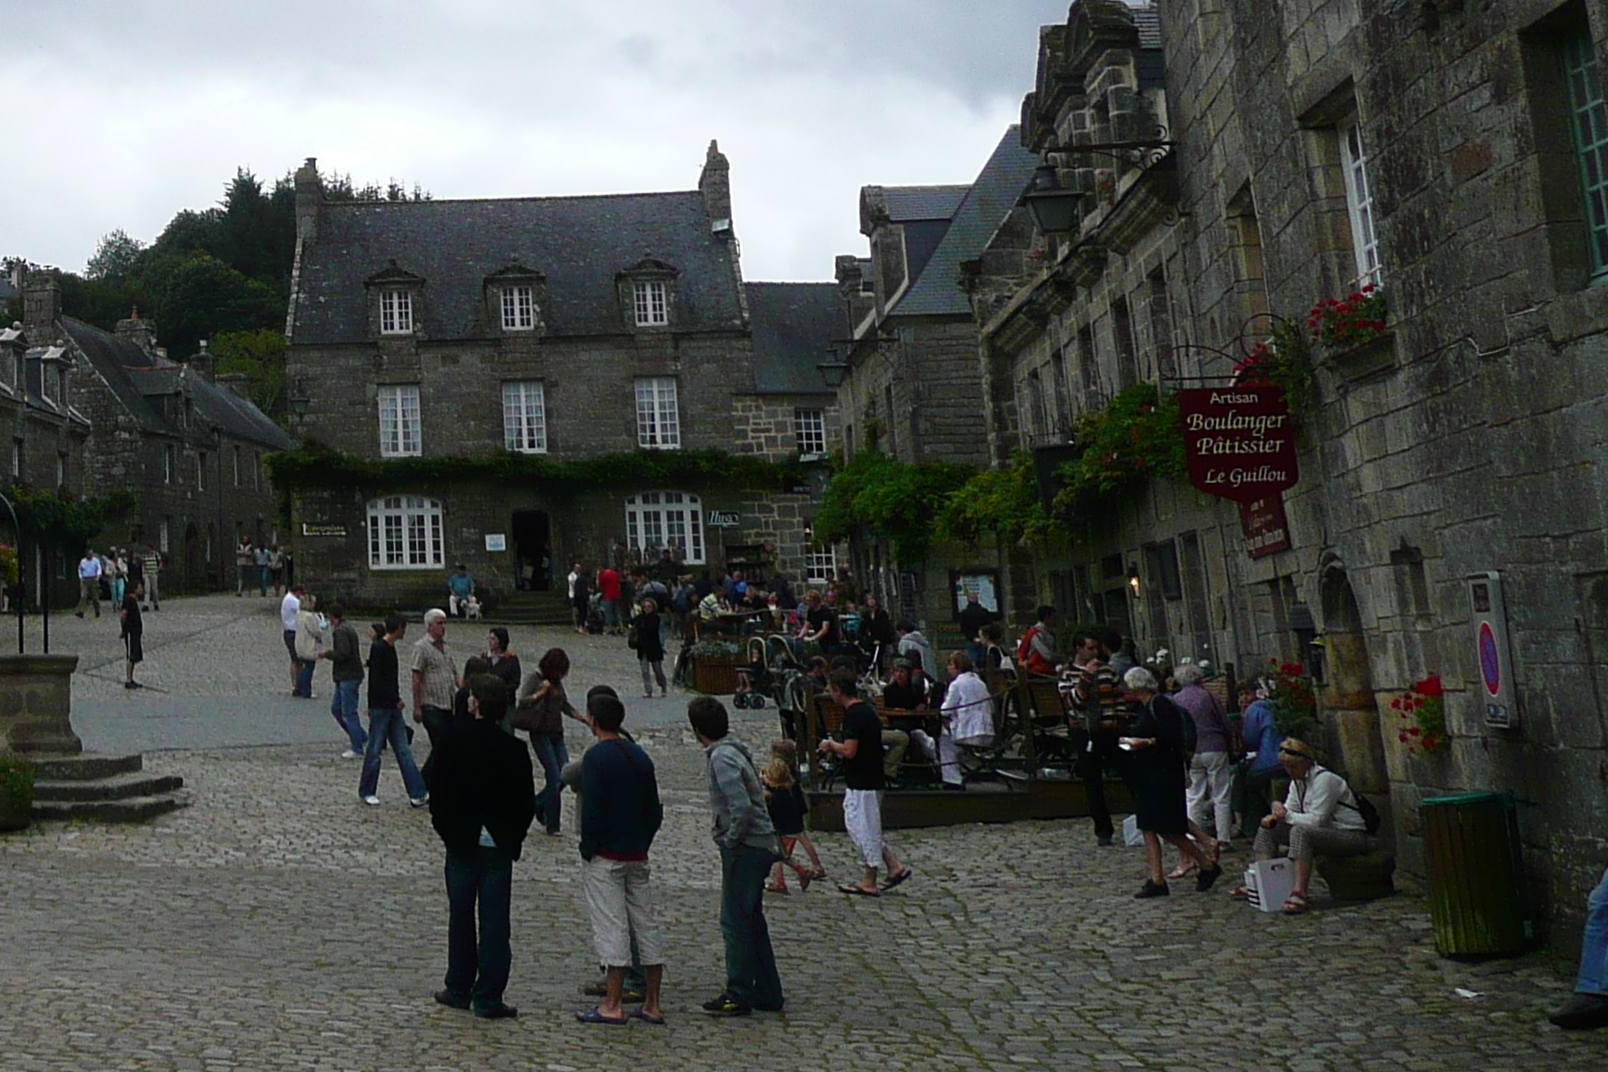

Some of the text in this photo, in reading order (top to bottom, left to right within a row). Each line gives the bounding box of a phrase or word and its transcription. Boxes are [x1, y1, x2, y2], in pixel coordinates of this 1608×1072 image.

[1209, 391, 1259, 405] Artisan
[1186, 409, 1287, 437] Boulanger
[1196, 435, 1285, 456] Pâtissier
[1204, 465, 1287, 488] Le Guillou
